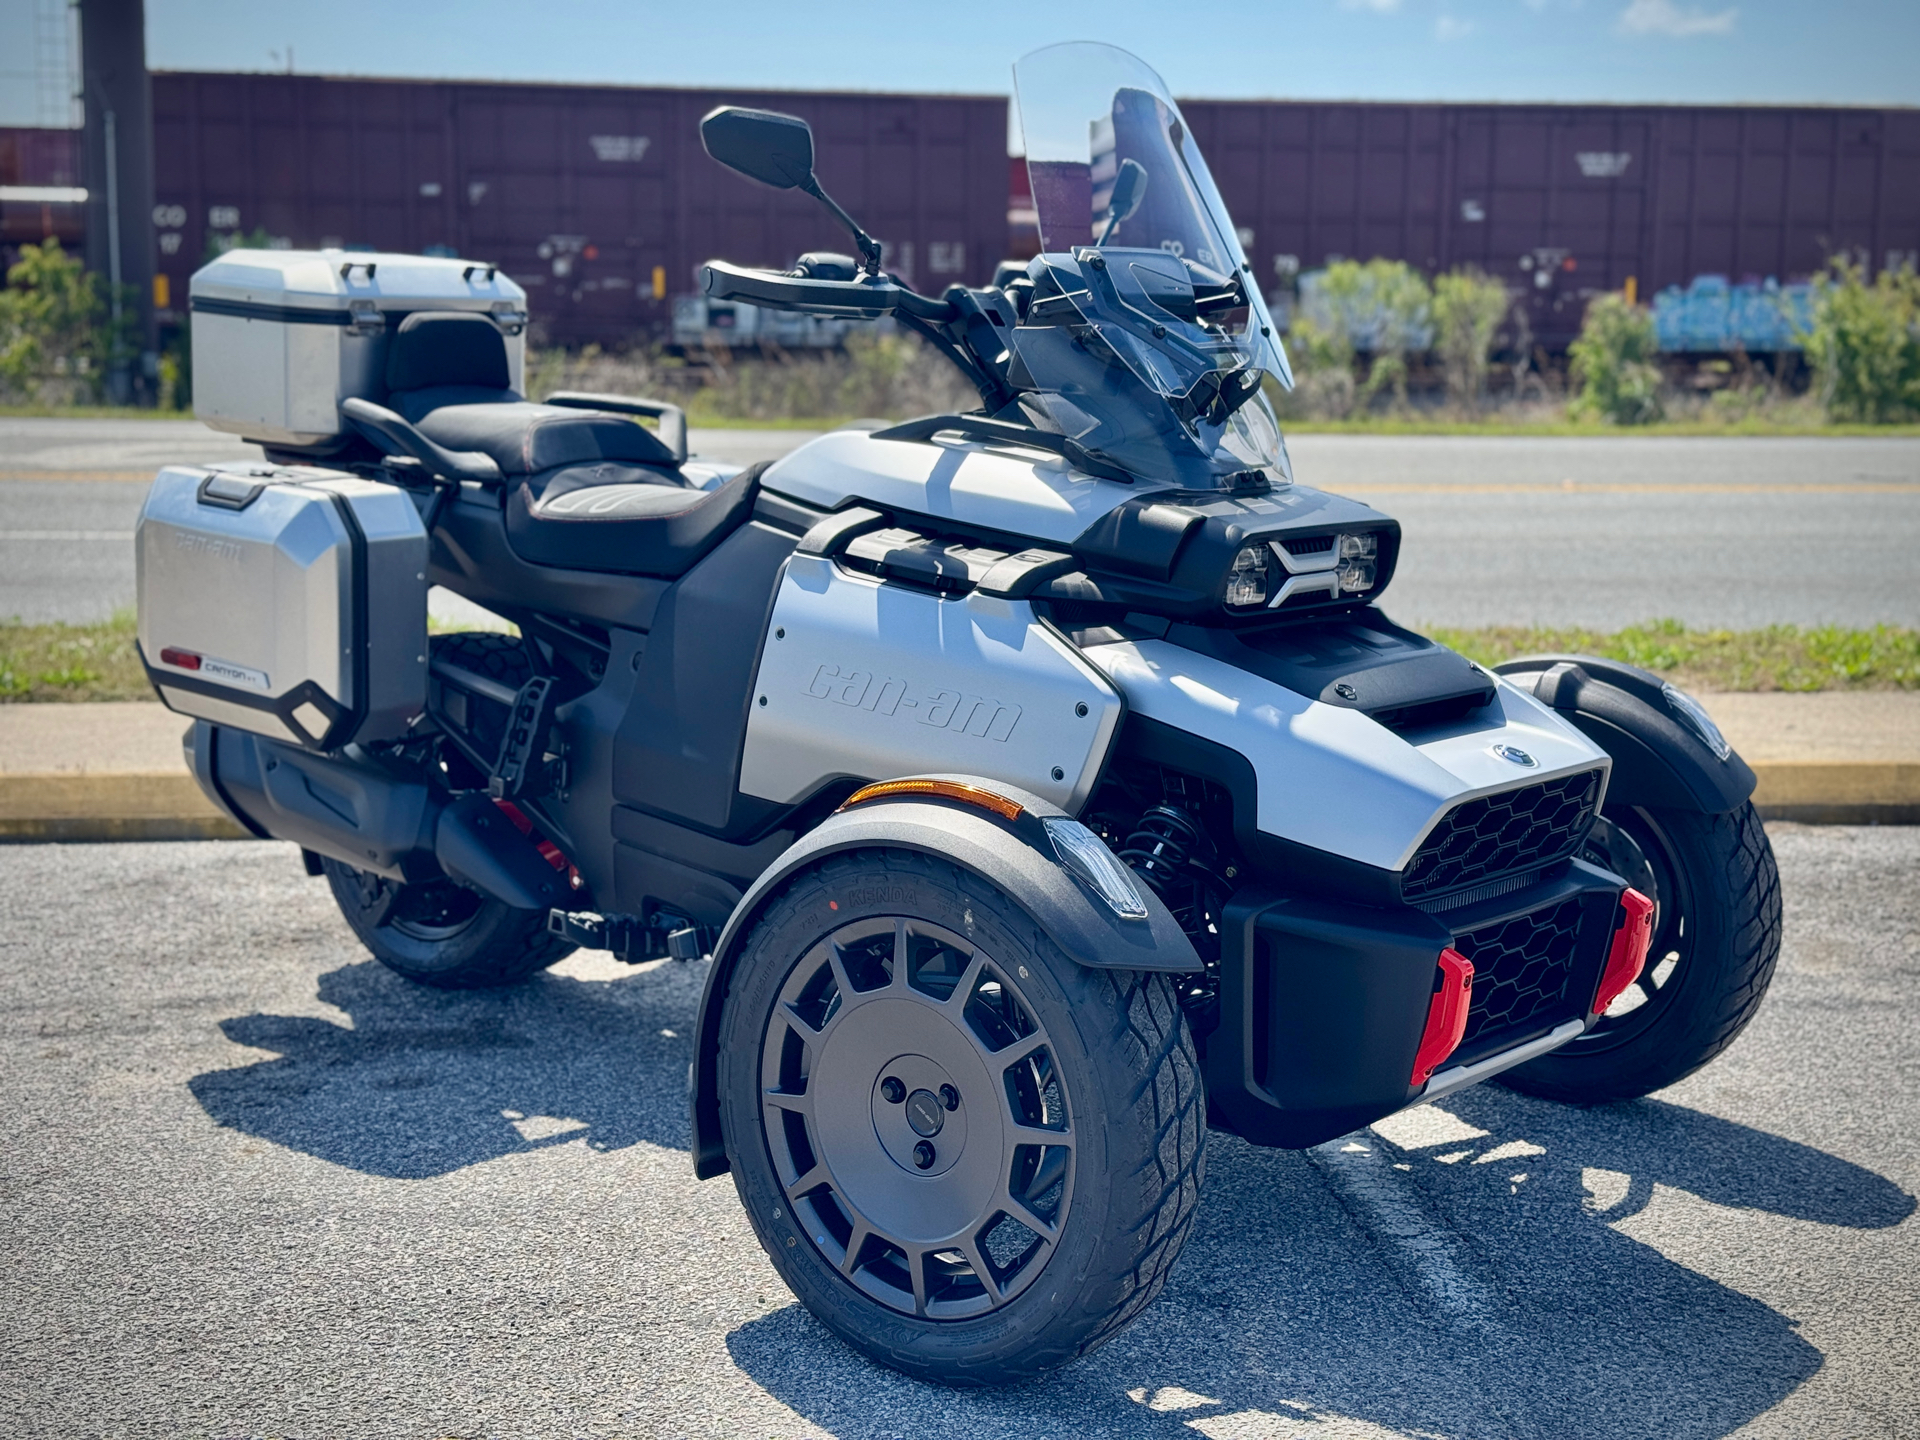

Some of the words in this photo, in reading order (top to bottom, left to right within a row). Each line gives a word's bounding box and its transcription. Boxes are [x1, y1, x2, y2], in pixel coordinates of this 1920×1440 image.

[176, 533, 242, 561] can-am
[205, 663, 246, 680] CANYON
[801, 664, 1023, 743] can-am
[848, 885, 918, 908] KENDA
